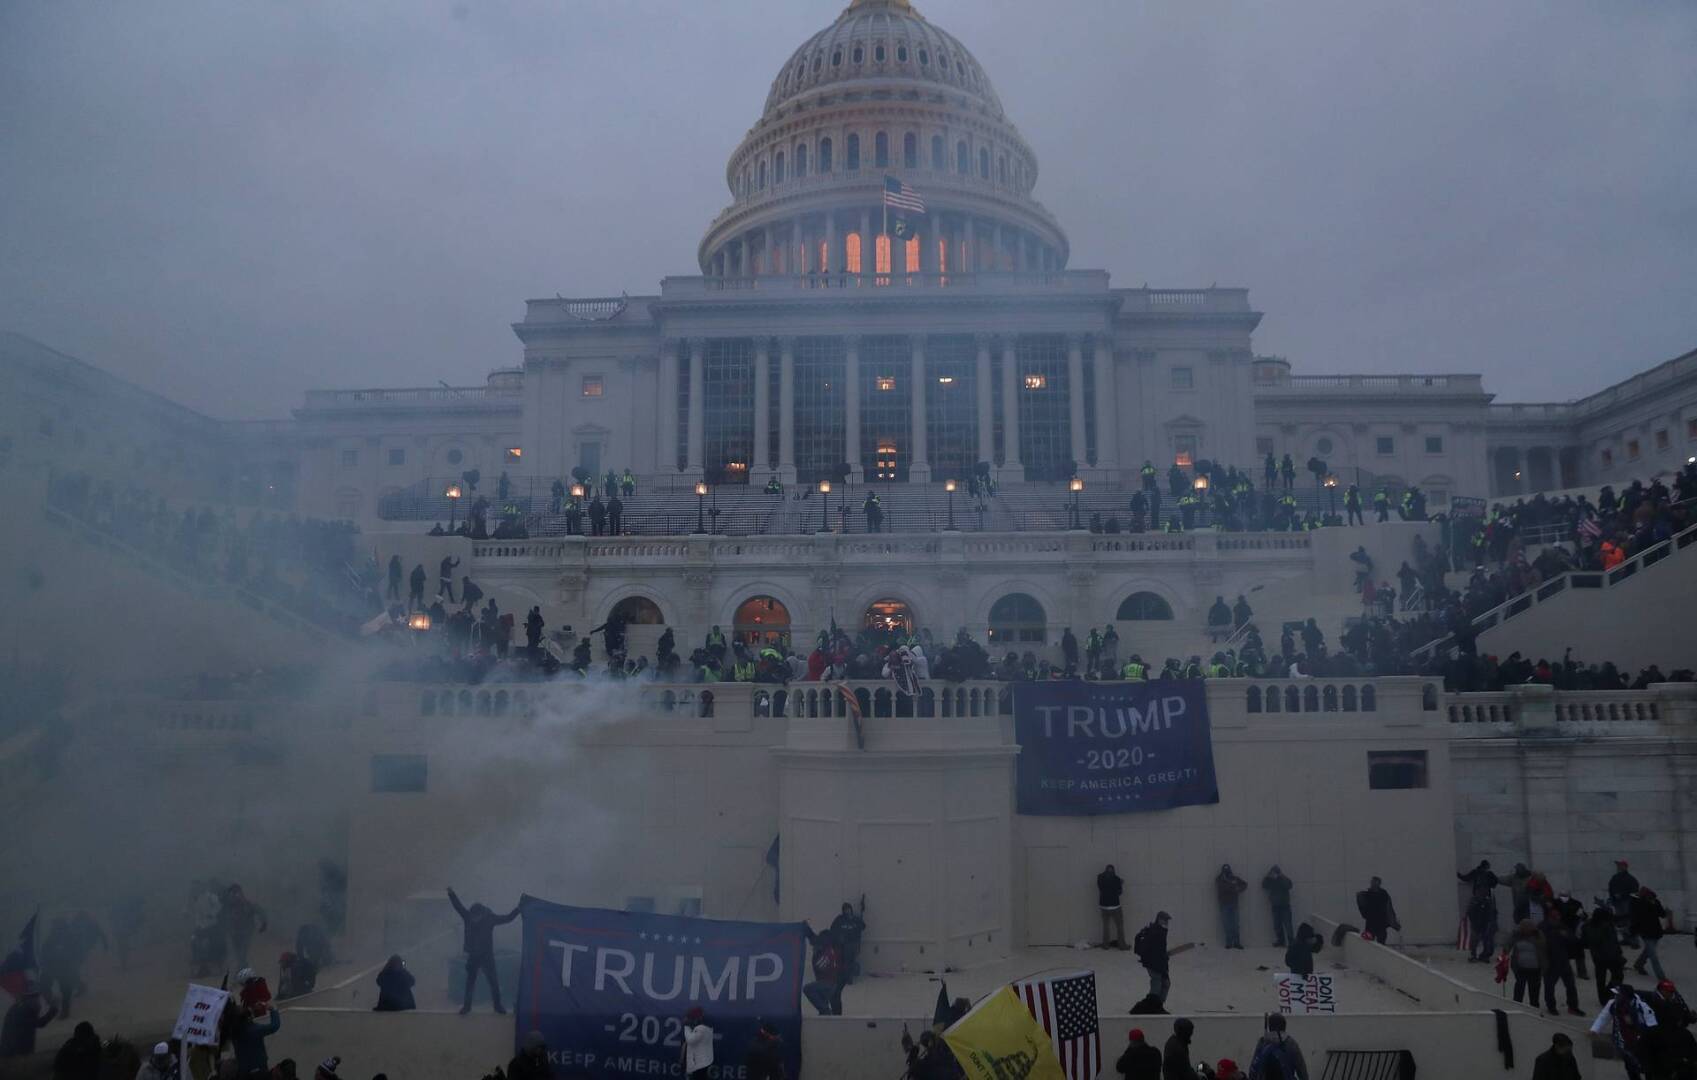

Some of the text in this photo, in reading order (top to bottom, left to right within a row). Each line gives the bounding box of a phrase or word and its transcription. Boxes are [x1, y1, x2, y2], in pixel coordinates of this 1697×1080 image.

[1035, 695, 1186, 738] TRUMP
[1077, 746, 1155, 770] -2020-
[1041, 778, 1075, 790] KEEP
[1080, 776, 1142, 790] AMERICA
[549, 940, 784, 1001] TRUMP
[1279, 978, 1291, 1012] VOTE
[1291, 983, 1306, 1004] MY
[1305, 975, 1319, 1012] STEAL
[604, 1013, 723, 1047] -202-
[546, 1049, 596, 1068] KEEP
[604, 1056, 685, 1077] AMERIC
